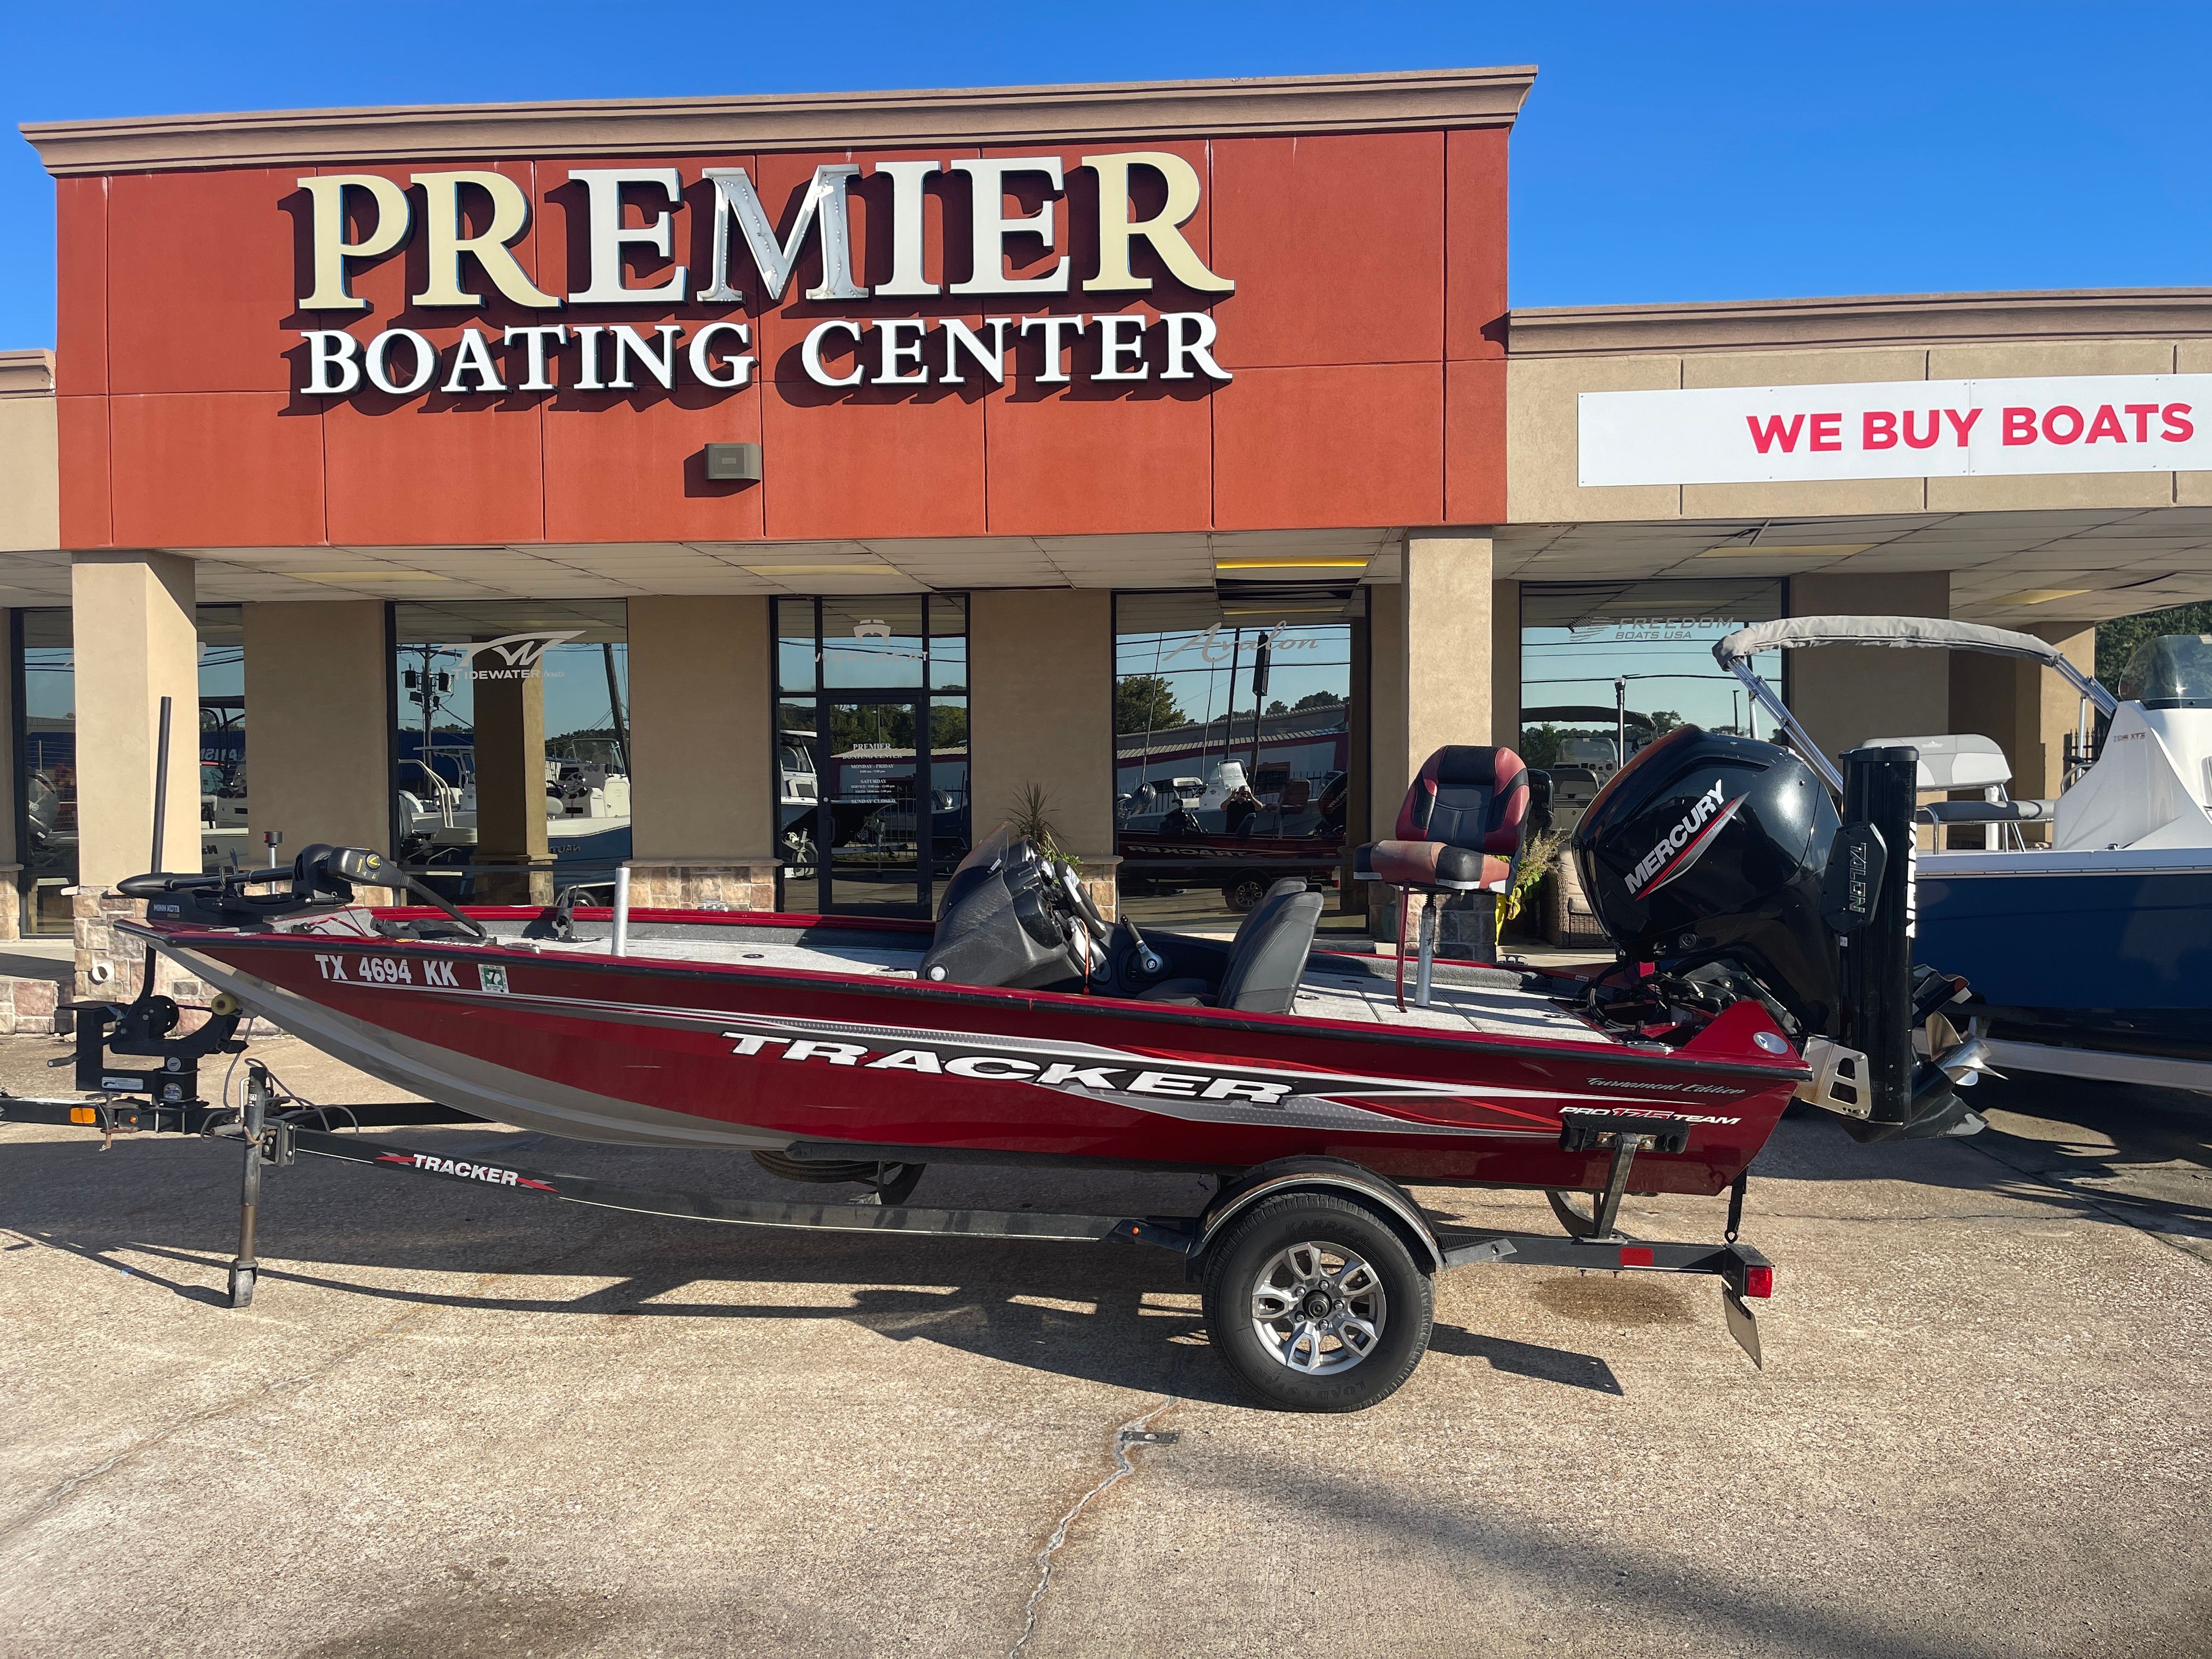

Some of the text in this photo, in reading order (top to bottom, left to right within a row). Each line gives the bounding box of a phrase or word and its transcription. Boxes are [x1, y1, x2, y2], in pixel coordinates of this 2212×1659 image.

[296, 151, 1236, 312] PREMIER
[300, 311, 1233, 395] BOATING CENTER
[1746, 403, 2194, 454] WE BUY BOATS
[1615, 631, 1692, 640] BOATS USA
[1618, 617, 1734, 629] FREEDOM
[1162, 620, 1319, 663] Avalon
[451, 668, 540, 680] TIDEWATER
[1624, 778, 1724, 895] MERCURY
[1849, 842, 1867, 913] TALON
[167, 905, 180, 913] KOTA
[314, 953, 460, 986] TX 4694 KK
[721, 1031, 1294, 1105] TRACKER
[1585, 1077, 1747, 1095] Tournament Edition
[1558, 1106, 1742, 1125] PRO 175 TEAM
[413, 1153, 519, 1187] TRACKER
[1285, 1220, 1370, 1244] KARRIER
